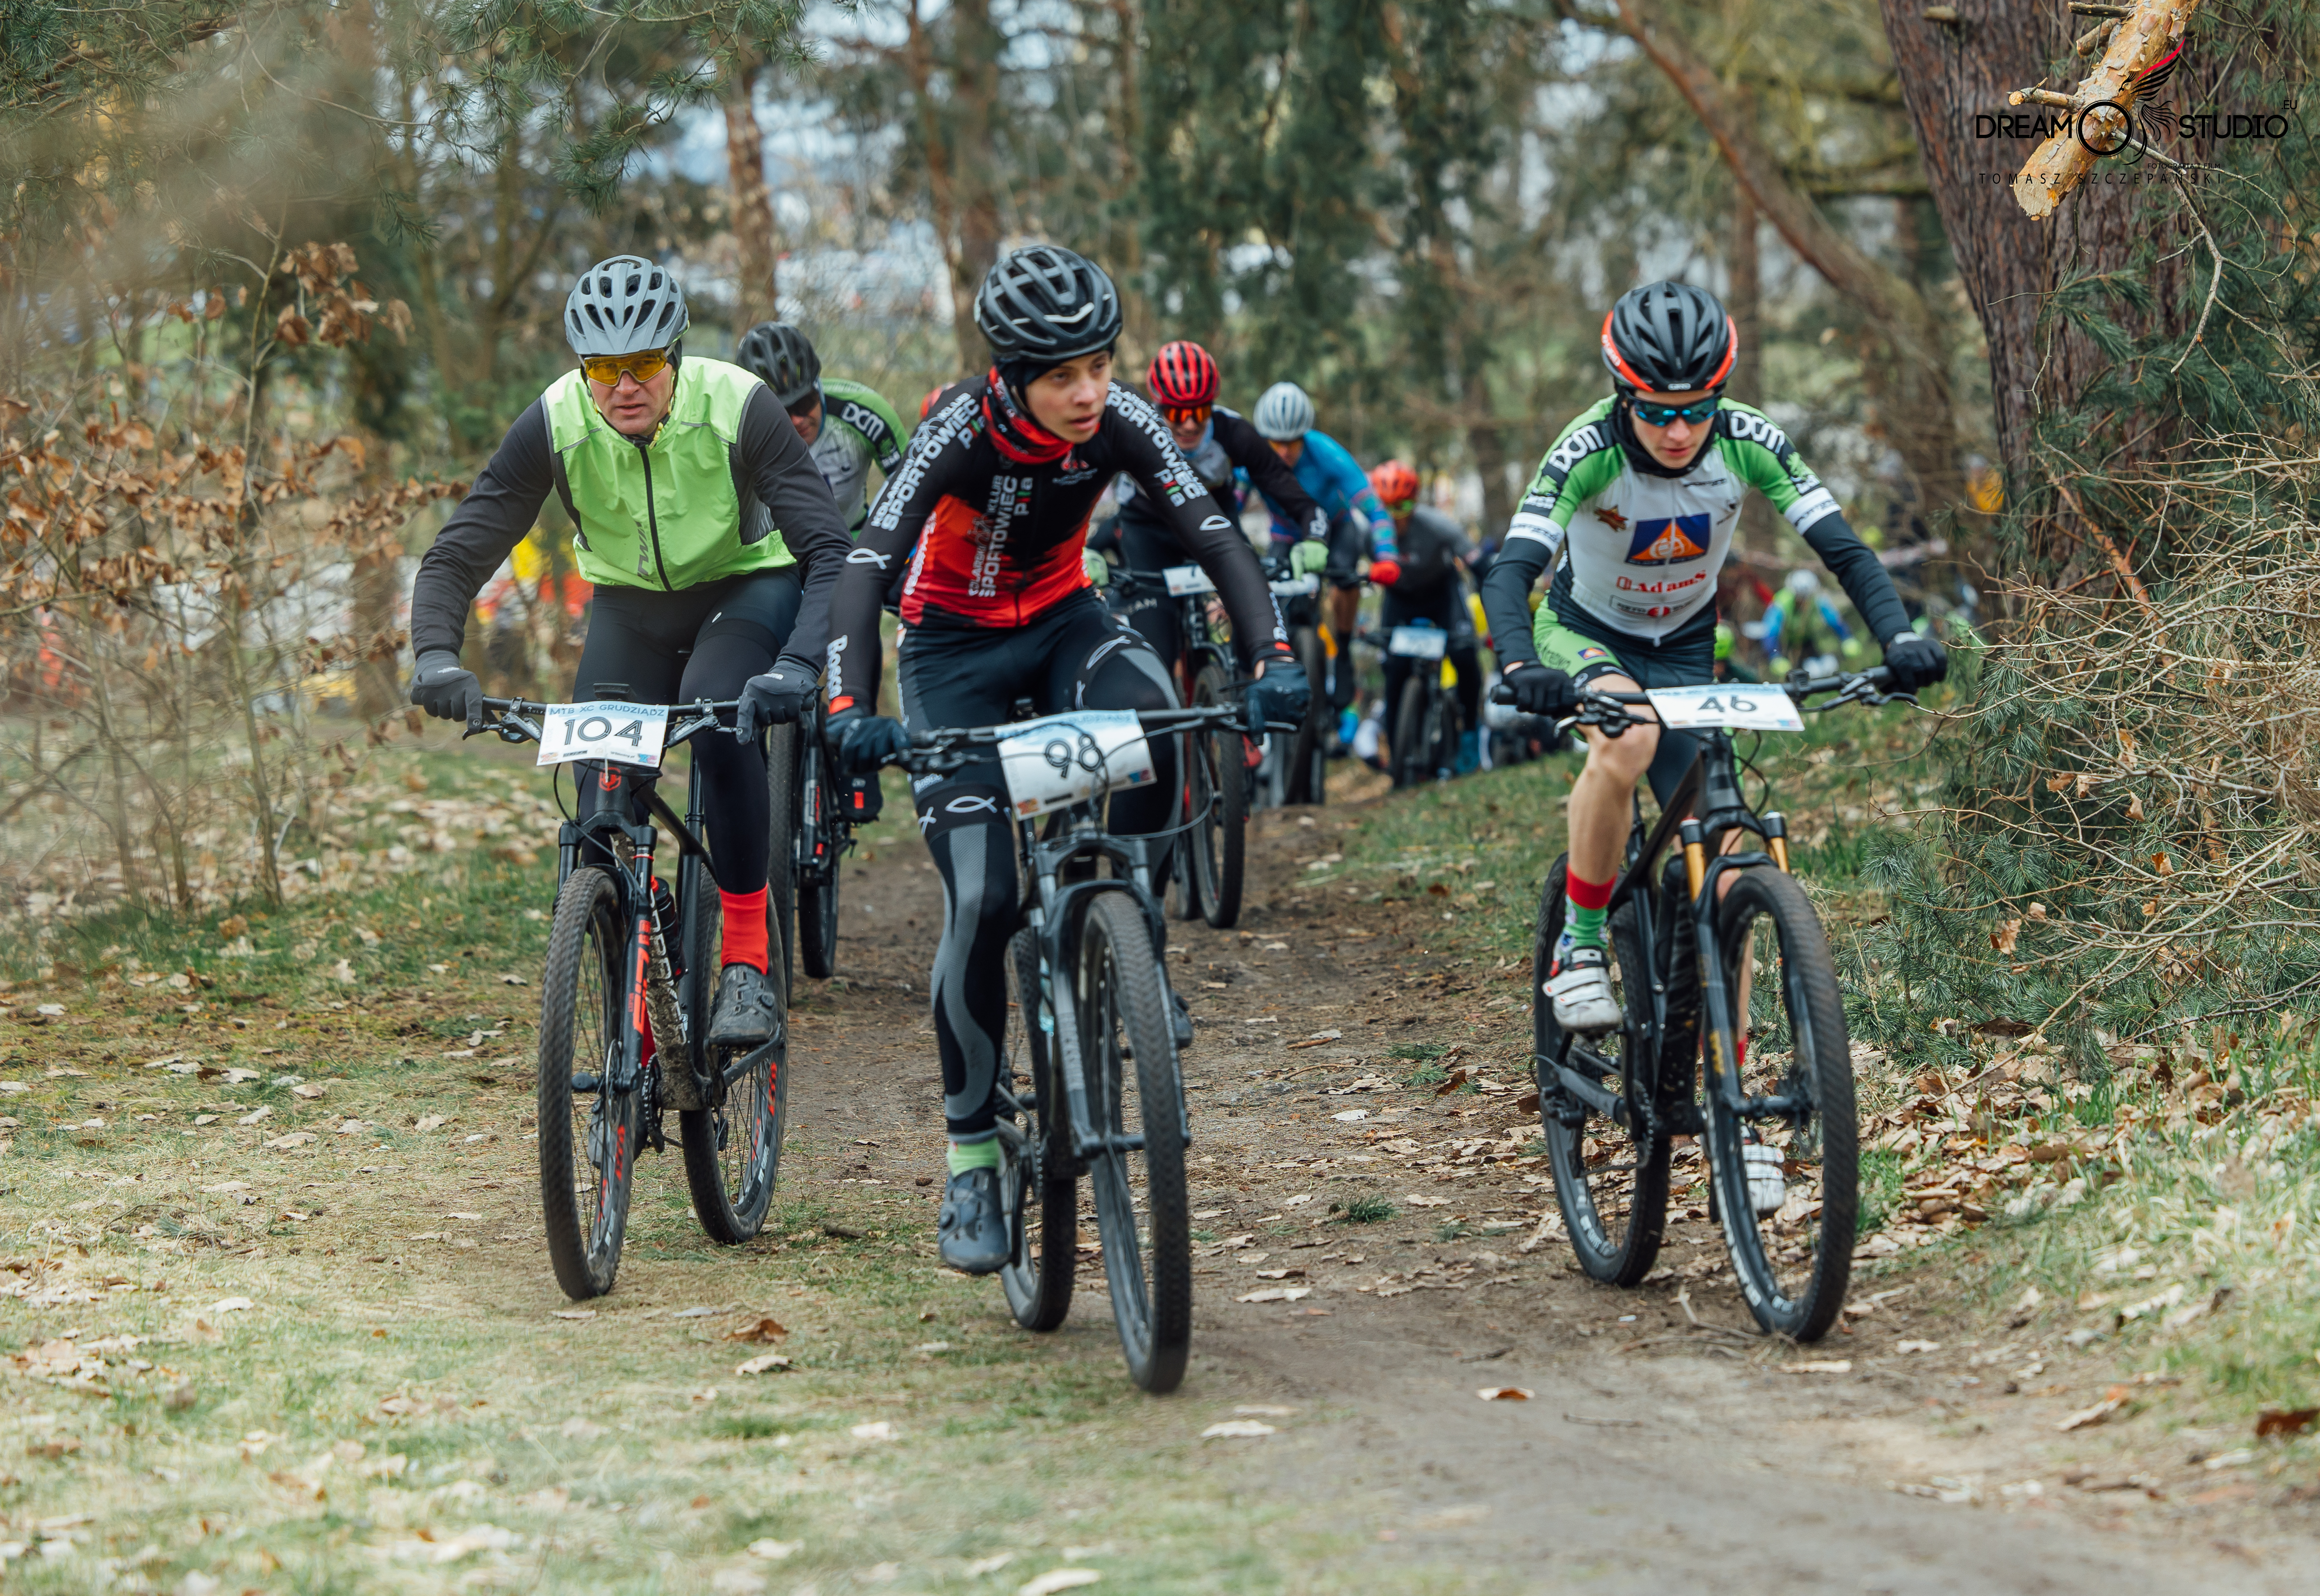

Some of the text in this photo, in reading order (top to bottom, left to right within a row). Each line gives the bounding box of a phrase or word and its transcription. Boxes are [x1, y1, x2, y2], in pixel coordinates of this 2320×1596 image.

[841, 402, 885, 442] DCM
[1731, 410, 1785, 454] DCM
[1548, 424, 1605, 473] DCM
[549, 707, 575, 715] MTB
[599, 704, 665, 717] GRUDZIĄDZ
[1697, 695, 1757, 713] 46
[564, 716, 643, 746] 104
[1045, 733, 1103, 779] 98
